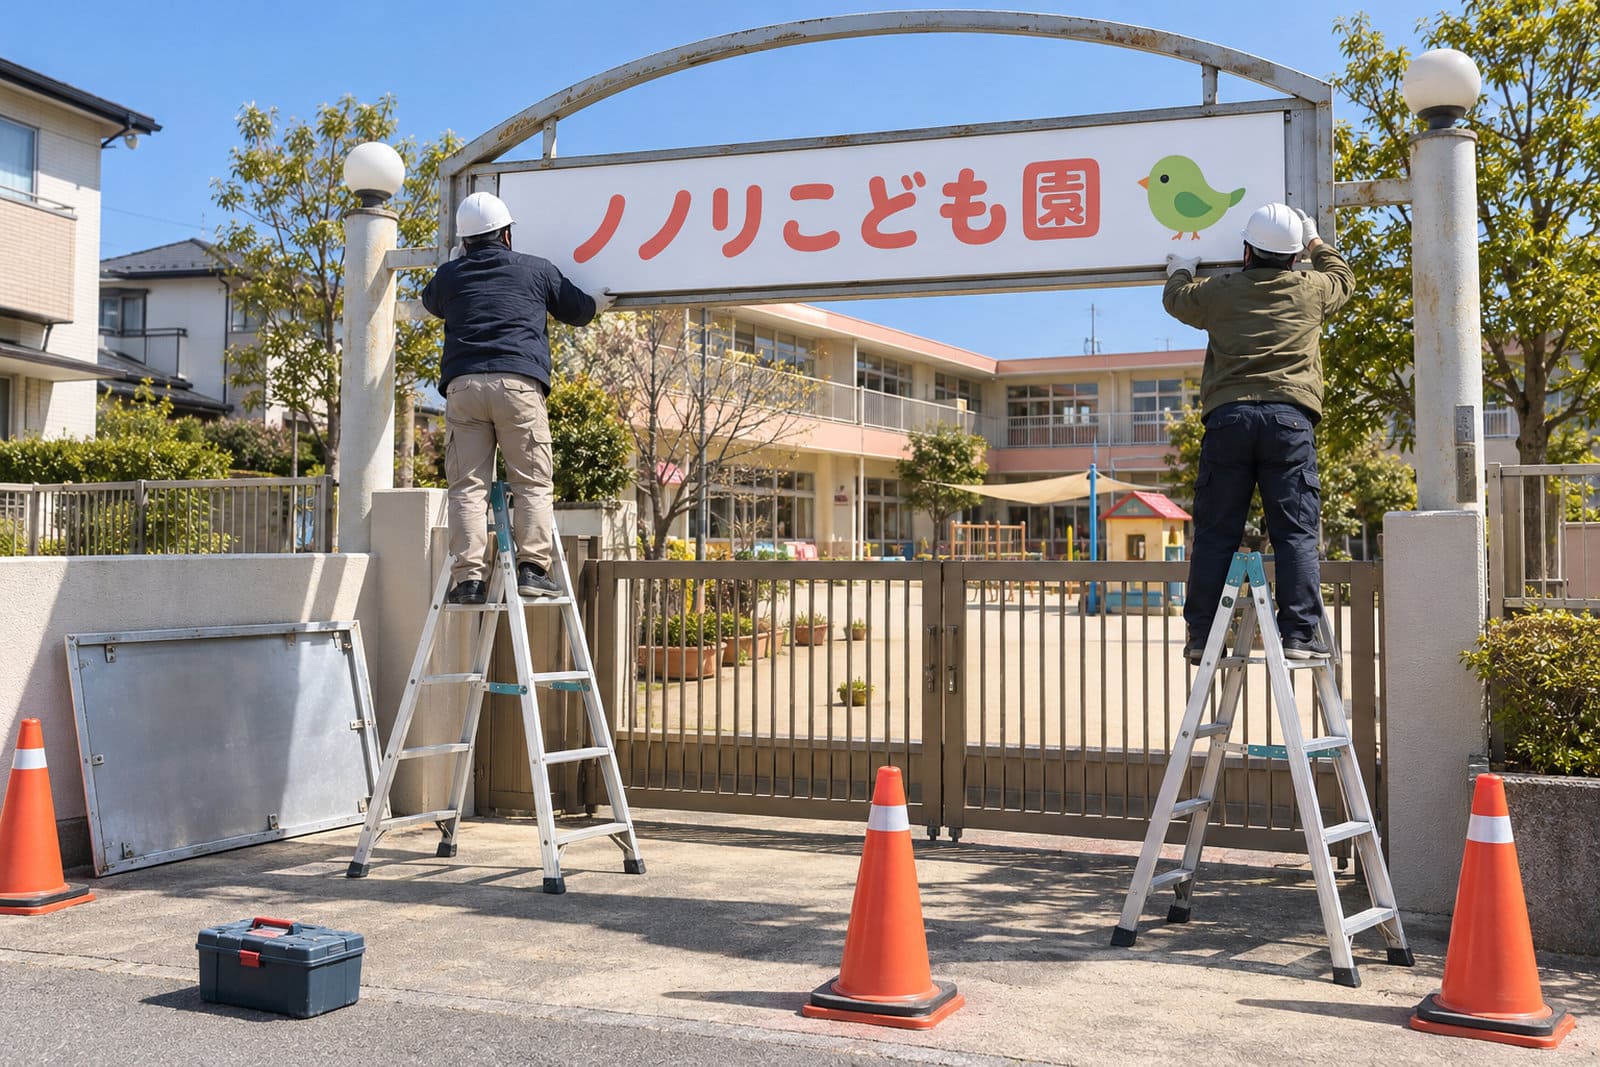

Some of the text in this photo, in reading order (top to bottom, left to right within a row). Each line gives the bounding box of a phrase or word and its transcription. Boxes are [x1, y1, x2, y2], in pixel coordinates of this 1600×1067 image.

[573, 158, 1101, 264] ノノリこども園
